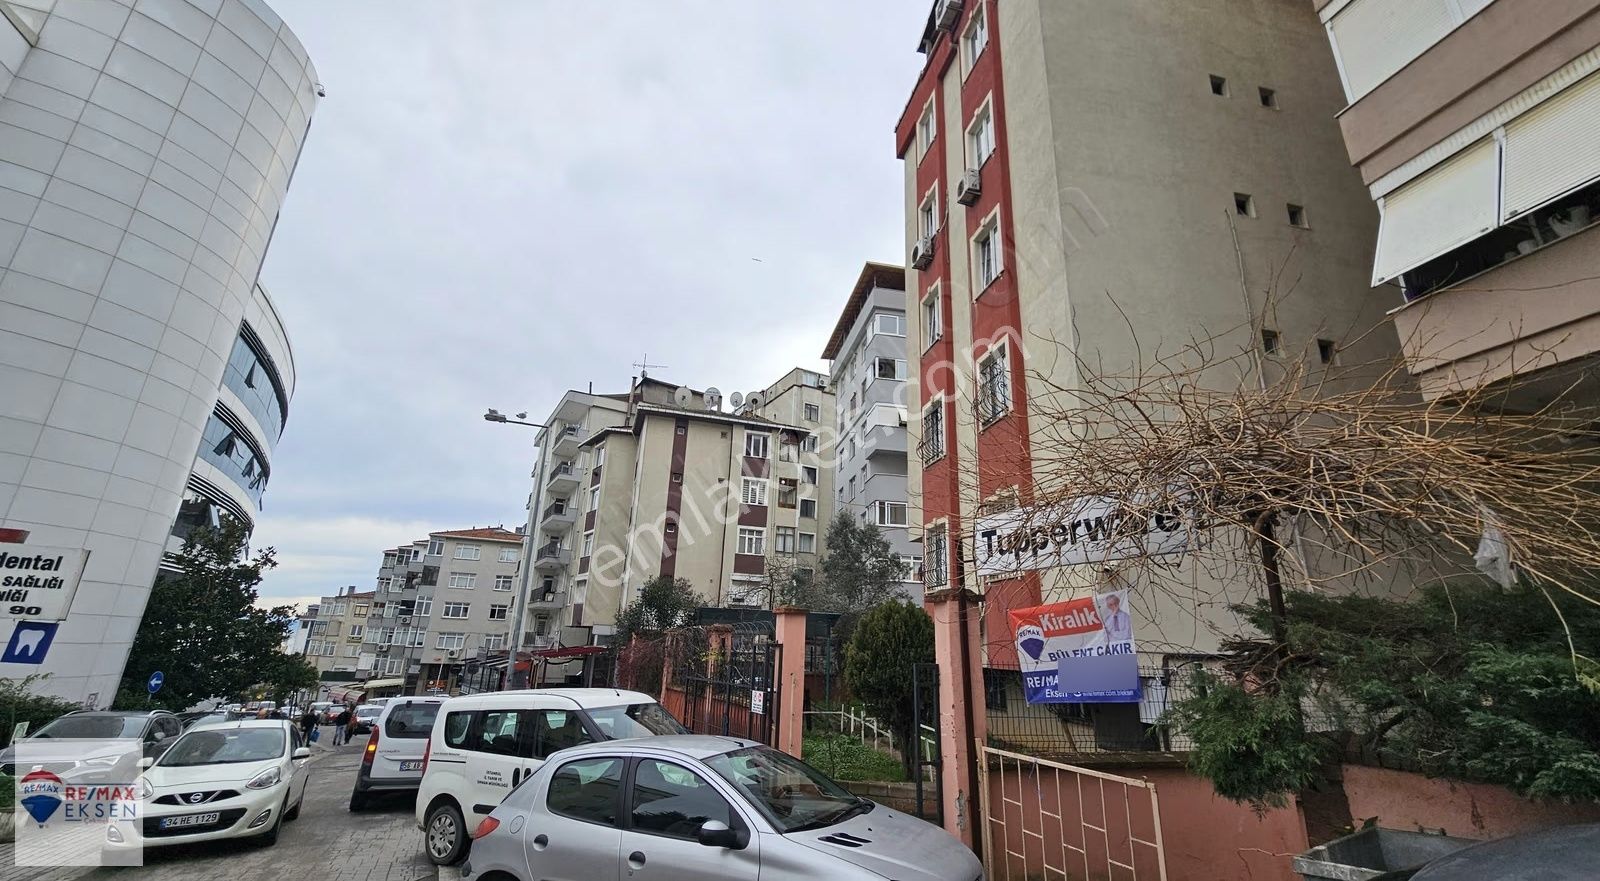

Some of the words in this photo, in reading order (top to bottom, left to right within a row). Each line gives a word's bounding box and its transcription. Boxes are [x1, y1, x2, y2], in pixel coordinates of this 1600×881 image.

[981, 505, 1181, 561] Tupperwe
[2, 574, 65, 589] SAĞLIĞI
[9, 605, 42, 615] 90
[1039, 607, 1100, 631] Kiralık
[1026, 674, 1059, 688] RE/MA
[167, 818, 178, 826] 34
[180, 816, 192, 825] HE
[195, 813, 217, 824] 1129
